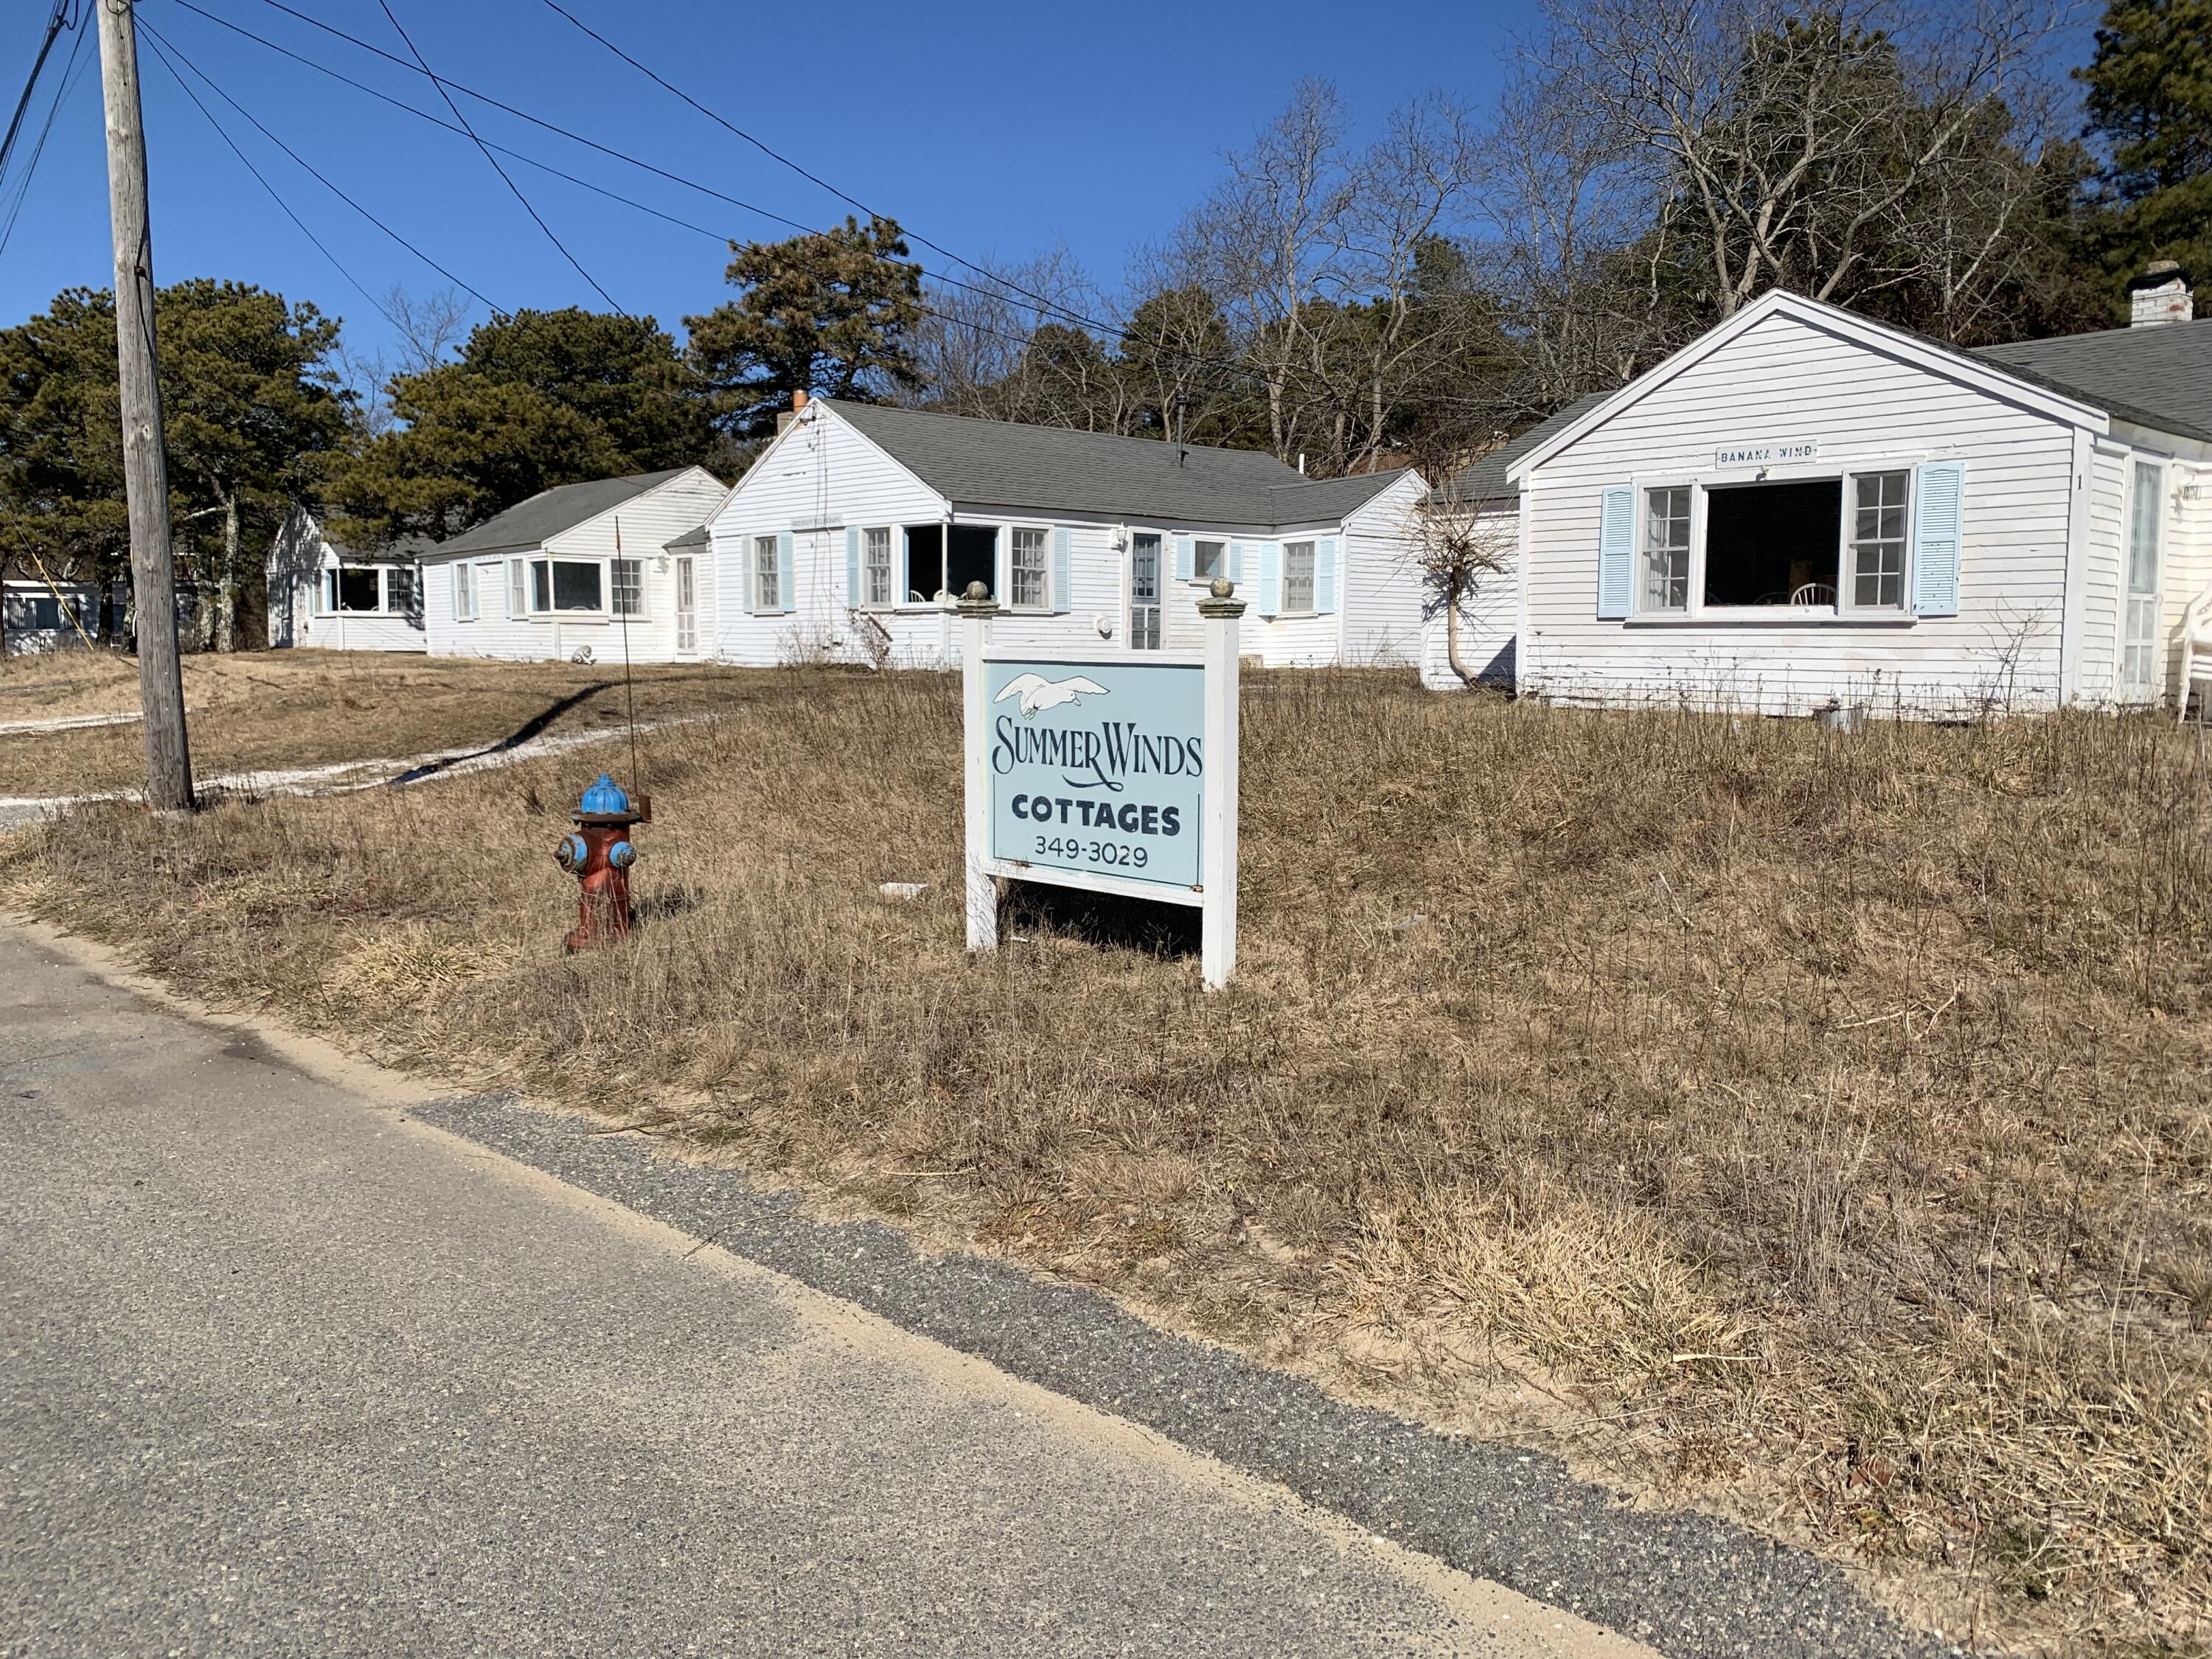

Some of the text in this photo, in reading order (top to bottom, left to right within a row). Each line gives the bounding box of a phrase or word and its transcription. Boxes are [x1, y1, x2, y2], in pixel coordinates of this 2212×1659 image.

[1721, 445, 1812, 463] BANANA WIND
[1011, 793, 1181, 837] COTTAGES
[1034, 835, 1149, 868] 349-3029
